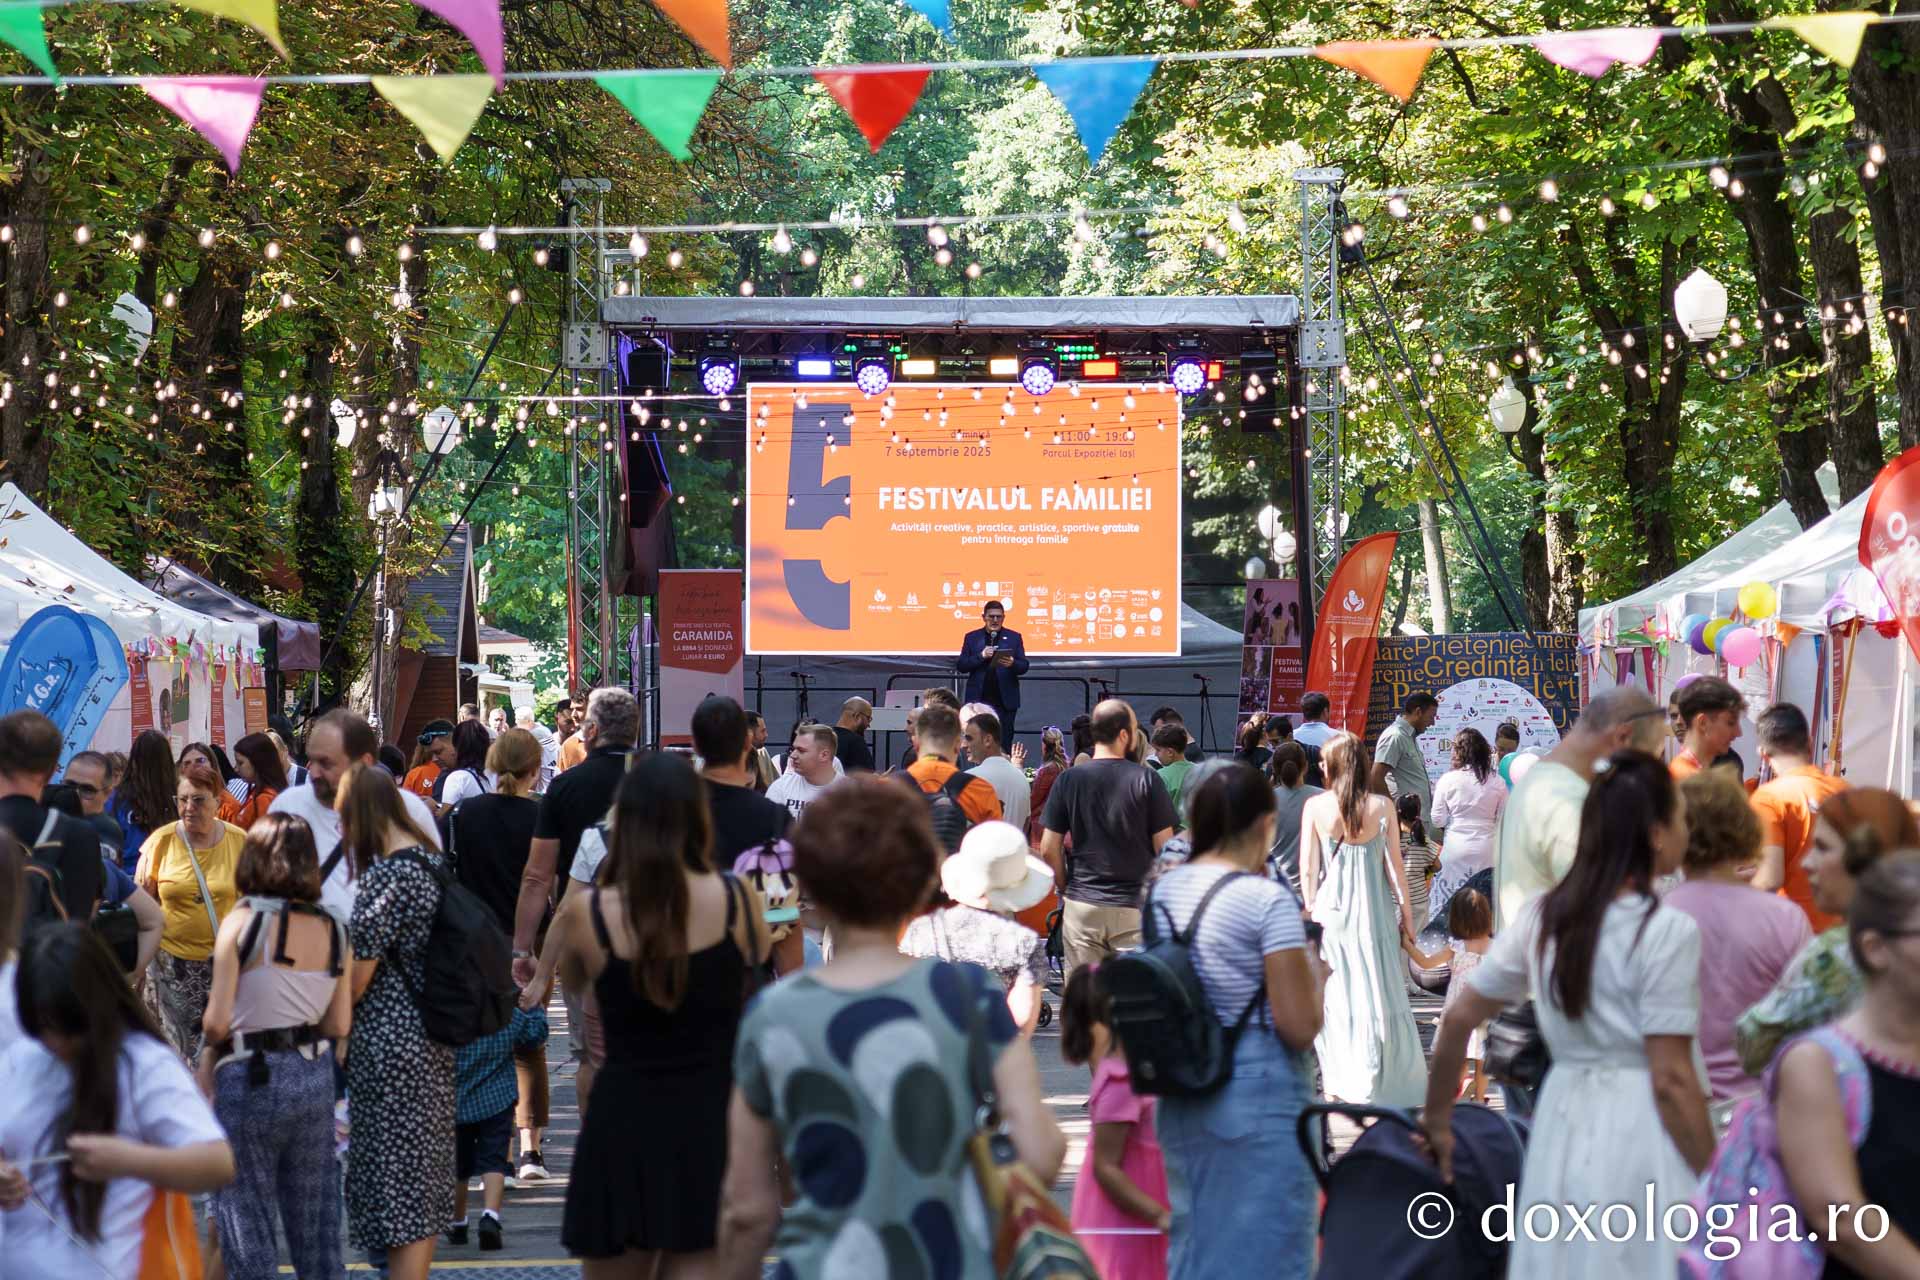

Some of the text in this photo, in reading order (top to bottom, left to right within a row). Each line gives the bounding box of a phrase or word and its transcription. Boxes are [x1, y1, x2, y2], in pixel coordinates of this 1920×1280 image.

[1060, 431, 1090, 441] 11:00
[885, 446, 991, 458] 7 septembrie 2025
[1042, 448, 1072, 458] Parcul
[878, 486, 1152, 511] FESTIVALUL FAMILIEI
[934, 523, 974, 533] creative,
[976, 523, 1016, 534] practice,
[1018, 523, 1060, 533] artistice,
[1062, 523, 1100, 534] sportive
[1102, 523, 1141, 535] gratuite
[961, 535, 992, 545] pentru
[1036, 534, 1070, 544] familie
[673, 630, 734, 641] CARAMIDA
[1415, 634, 1525, 656] Prietenie
[1424, 654, 1530, 683] Credință
